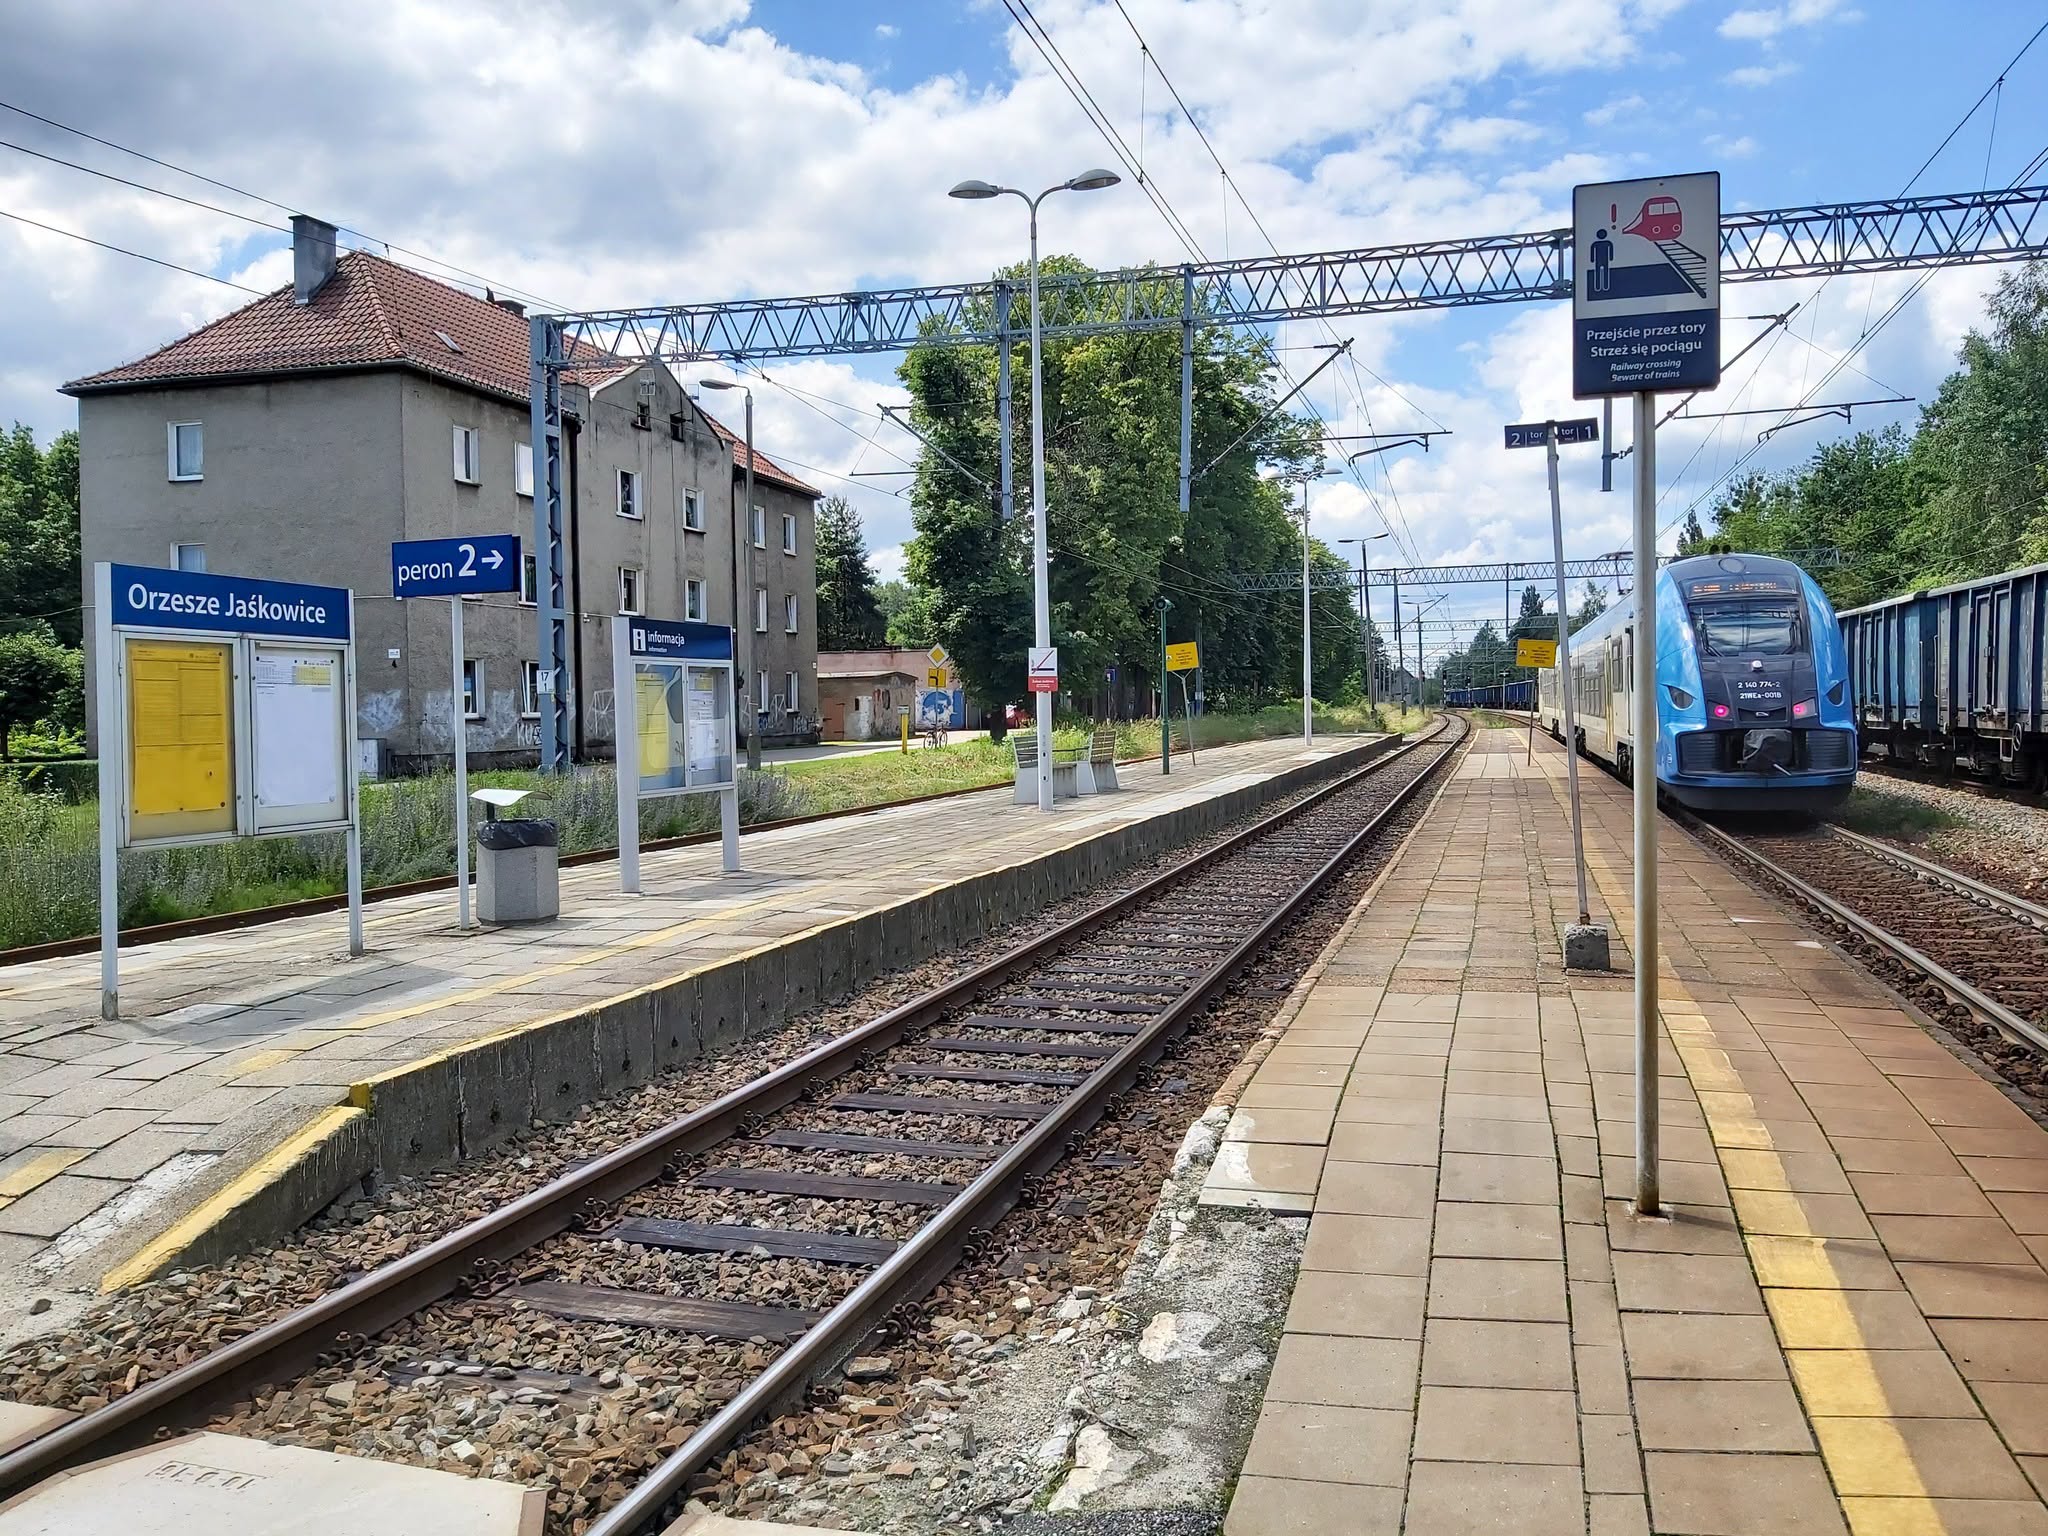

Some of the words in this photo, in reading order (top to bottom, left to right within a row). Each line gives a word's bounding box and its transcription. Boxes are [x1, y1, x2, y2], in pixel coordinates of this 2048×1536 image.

[1586, 326, 1641, 342] Przejście
[1643, 325, 1677, 339] przez
[1680, 322, 1706, 336] tory
[1590, 344, 1628, 358] Strzeż
[1631, 342, 1649, 356] się
[1651, 340, 1702, 355] pociągu
[1610, 361, 1644, 372] Railway
[1646, 358, 1682, 370] crossing
[1611, 372, 1643, 382] Beware
[1644, 371, 1655, 380] of
[1655, 369, 1681, 379] trains
[1511, 433, 1521, 446] 2
[1530, 430, 1543, 439] tor
[1561, 427, 1575, 436] tor
[1585, 426, 1592, 439] 1
[397, 558, 453, 587] peron
[458, 544, 477, 578] 2
[128, 583, 220, 616] Orzesze
[225, 592, 327, 625] Jaśkowice
[647, 630, 685, 648] informacja
[541, 671, 549, 681] 17
[544, 683, 547, 692] 1
